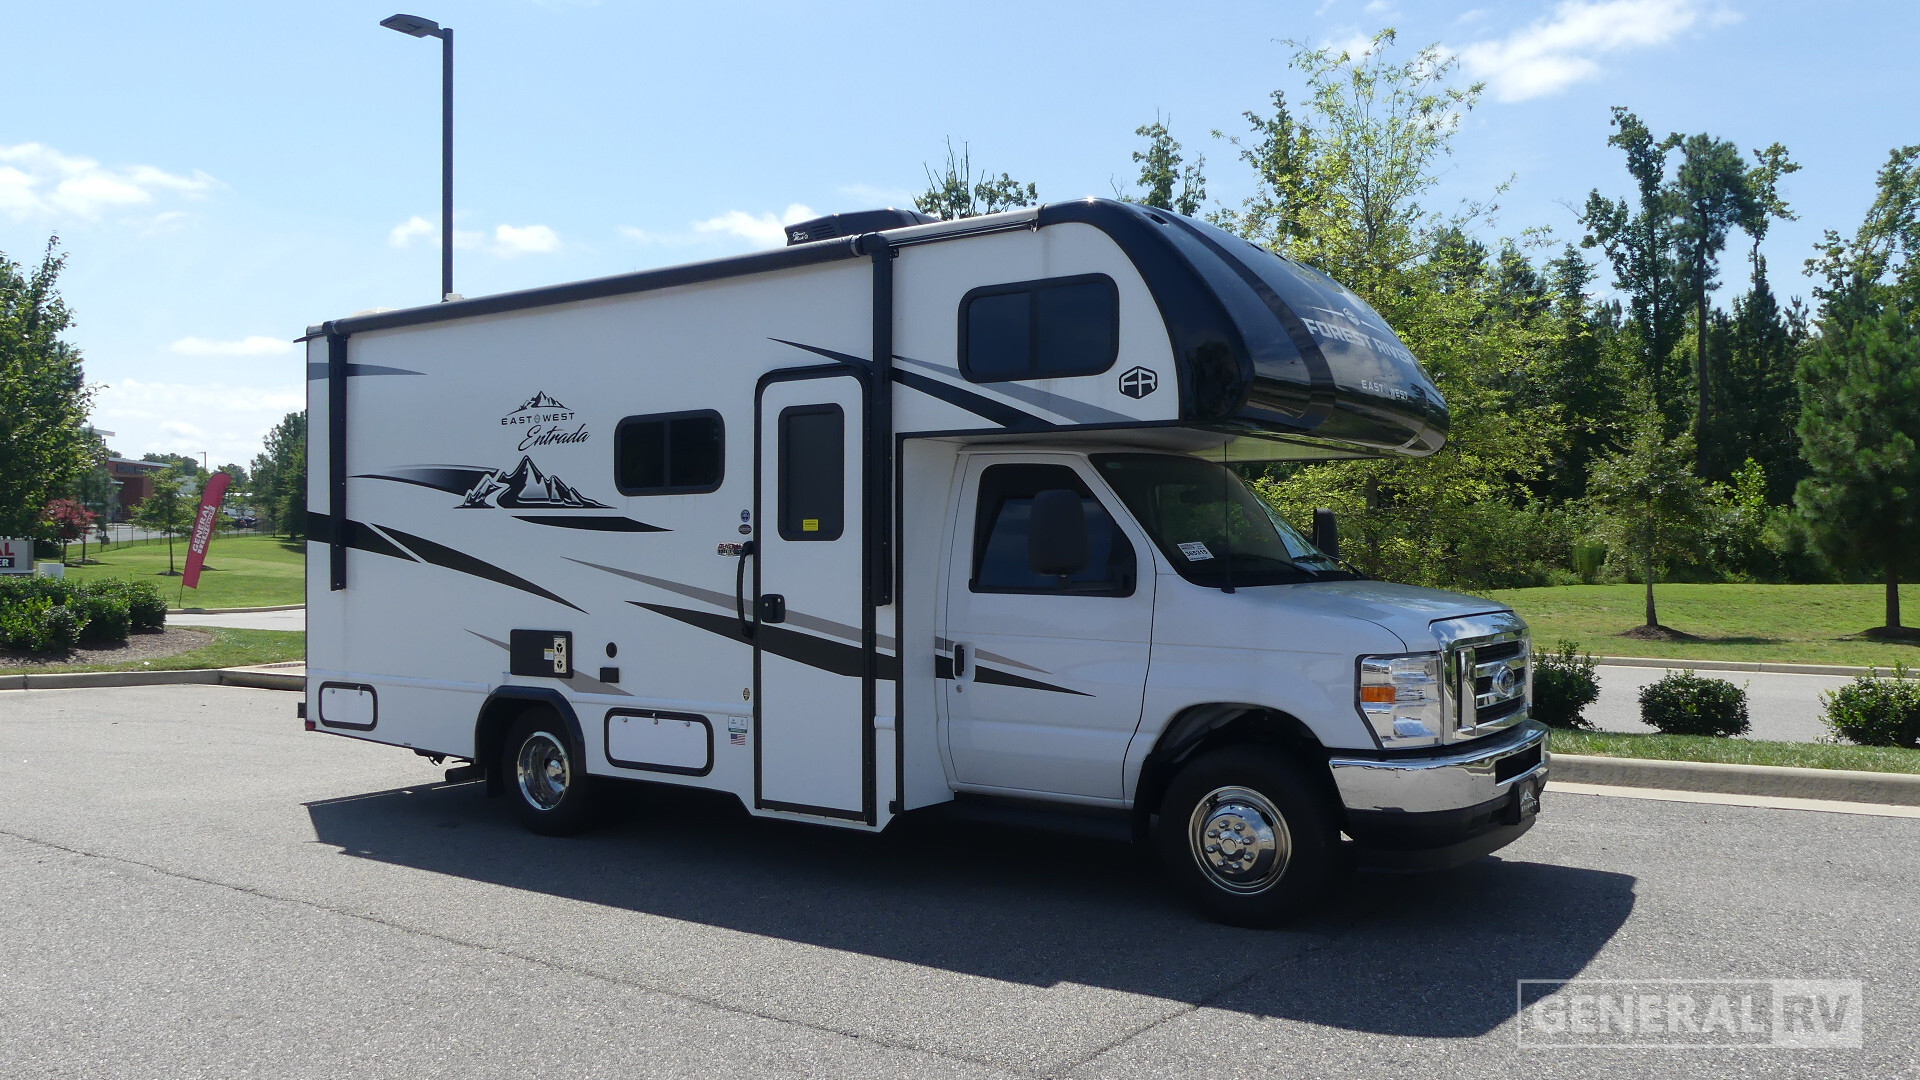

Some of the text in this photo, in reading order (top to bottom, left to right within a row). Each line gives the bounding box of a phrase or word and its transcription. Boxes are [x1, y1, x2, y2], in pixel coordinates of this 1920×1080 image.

[1301, 317, 1413, 366] FOREST RIVER
[1361, 379, 1408, 400] EAST WEST
[501, 412, 575, 426] EAST WEST
[517, 423, 590, 452] Entrada
[193, 504, 213, 552] GENERAL
